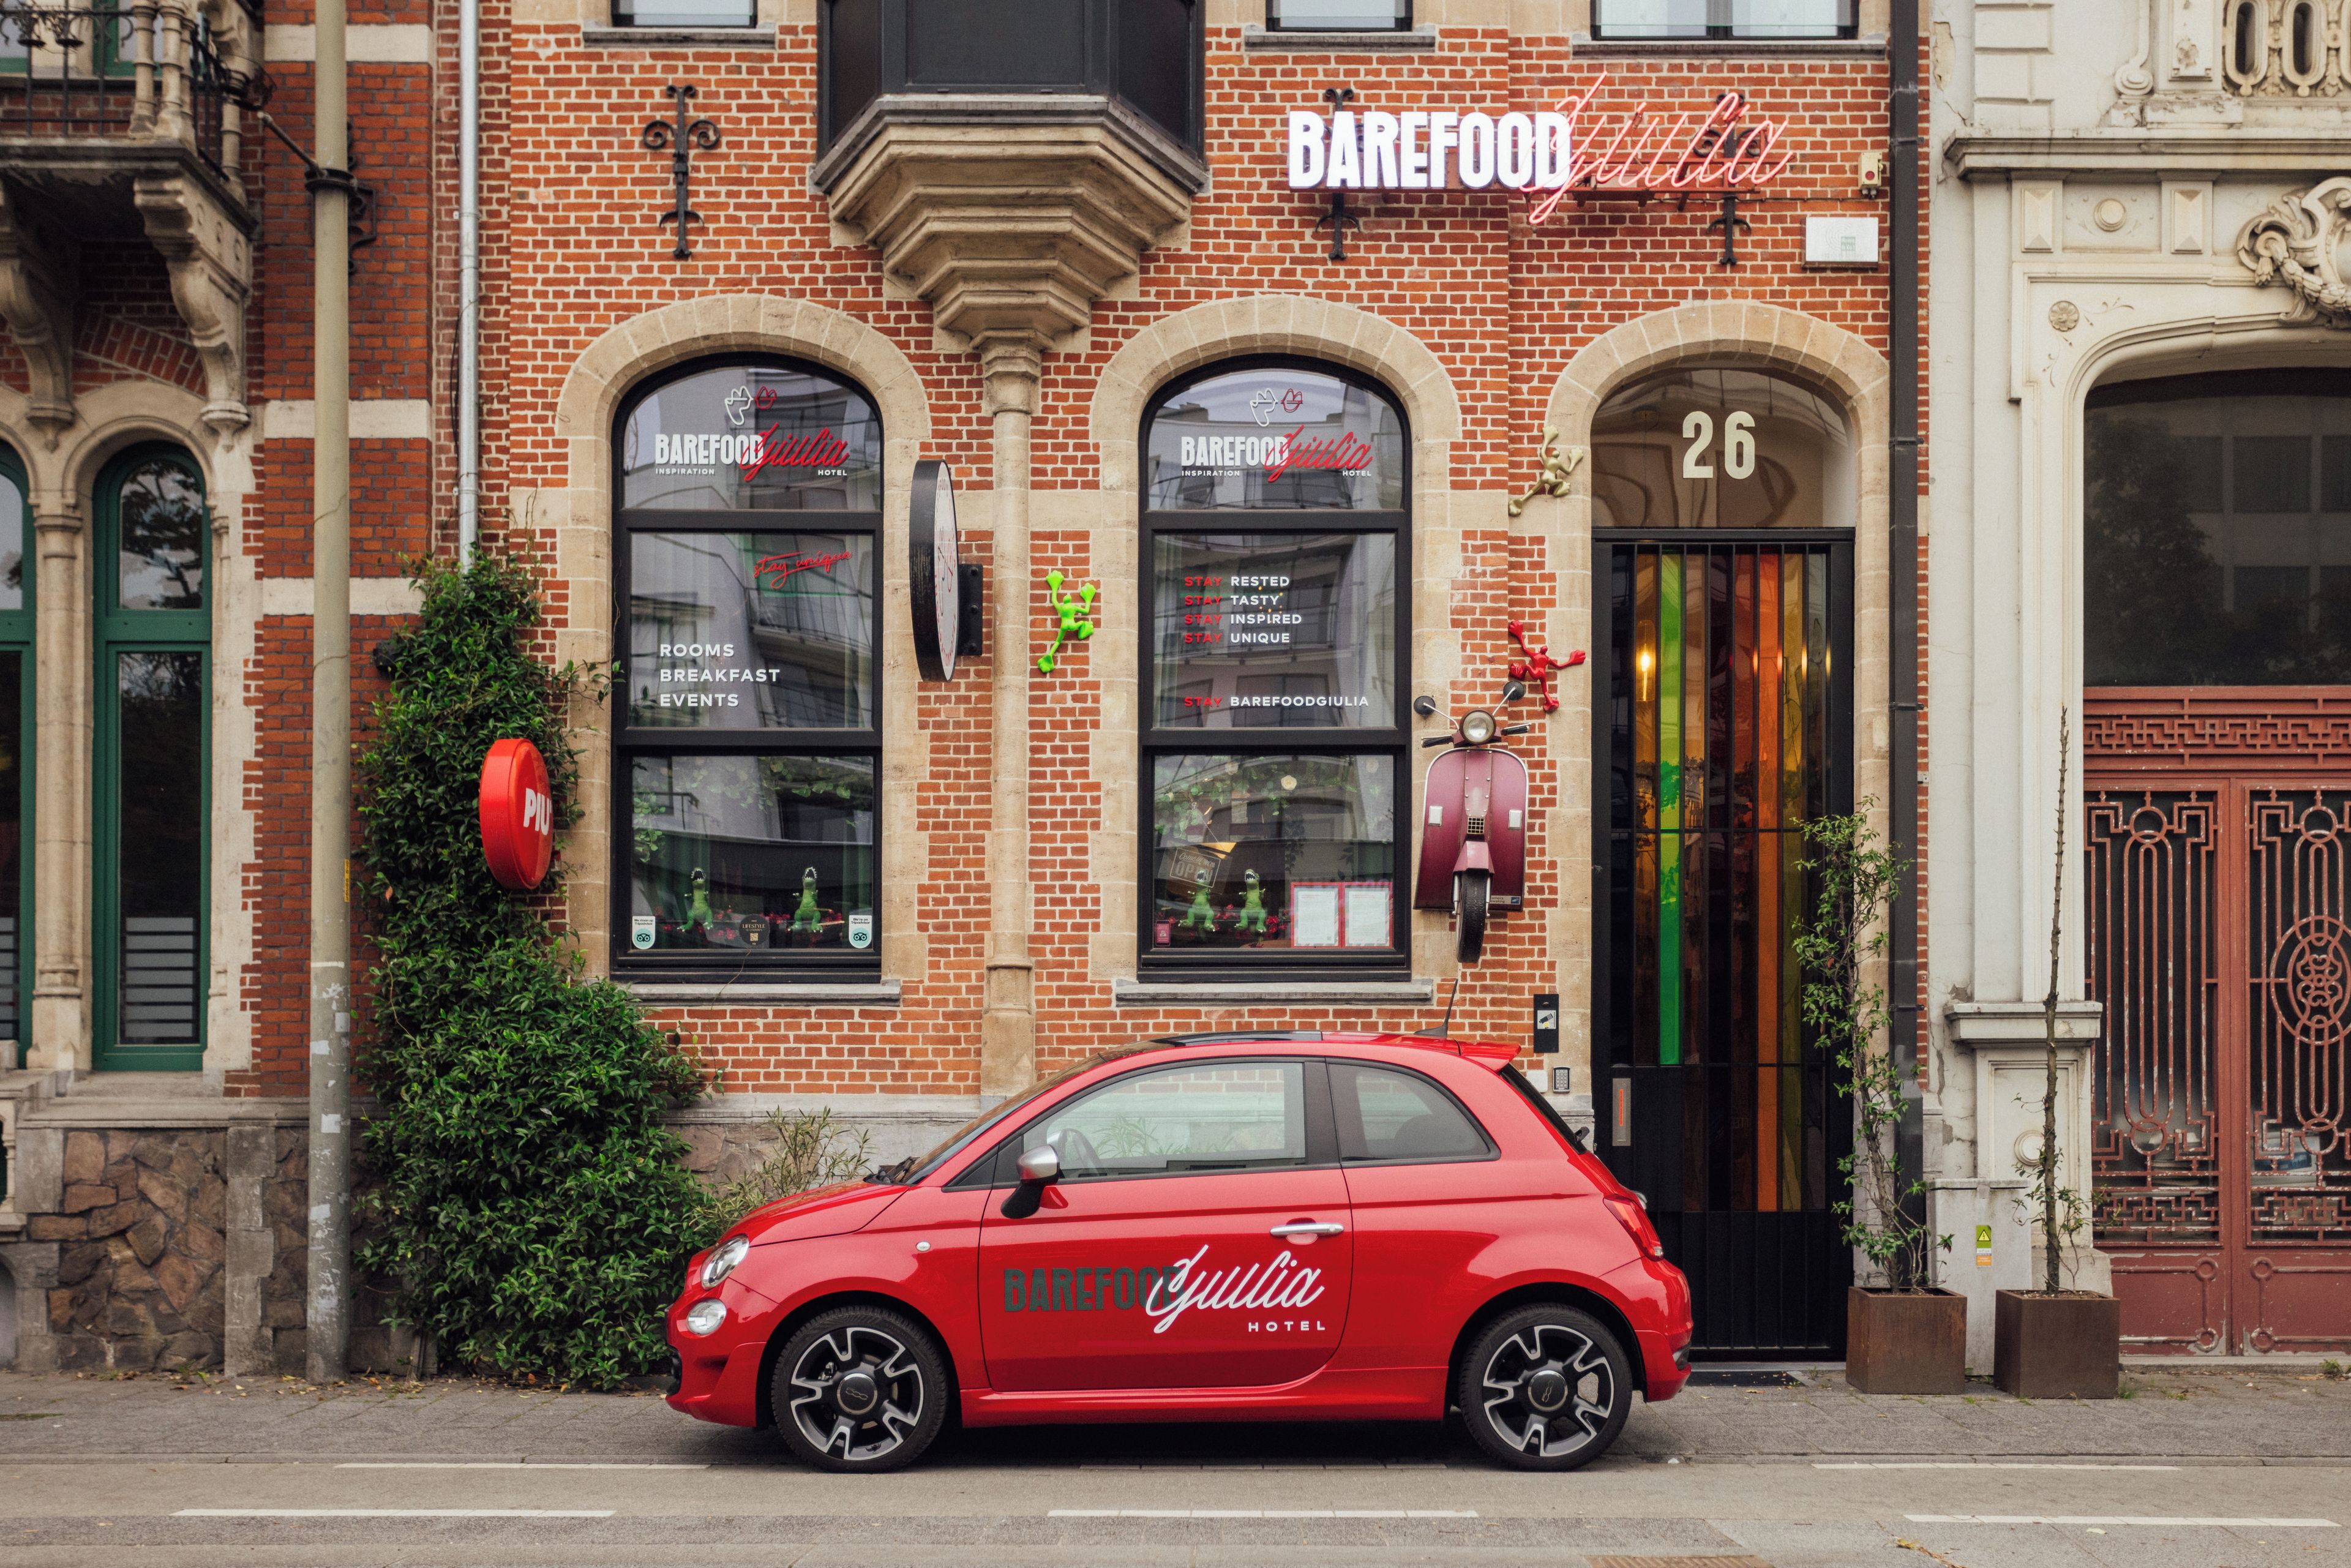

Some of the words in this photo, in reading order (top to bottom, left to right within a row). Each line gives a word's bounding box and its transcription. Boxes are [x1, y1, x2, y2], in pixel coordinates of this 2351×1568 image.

[1288, 111, 1572, 188] BAREFOOD
[1520, 70, 1794, 225] Giulia
[1682, 411, 1755, 479] 26
[655, 434, 764, 465] BAREFOOD
[740, 422, 850, 482] Giulia
[1181, 436, 1289, 467] BAREFOOD
[1264, 424, 1373, 482] Giulia
[752, 552, 794, 590] stay
[796, 550, 853, 573] unique
[1185, 577, 1222, 587] STAY
[1231, 577, 1289, 587] RESTED
[1185, 595, 1222, 605] STAY
[1231, 595, 1279, 605] TASTY
[1185, 614, 1222, 624] STAY
[1231, 614, 1302, 624] INSPIRED
[1185, 633, 1222, 643] STAY
[1231, 633, 1290, 643] UNIQUE
[660, 644, 734, 657] ROOMS
[660, 669, 780, 682] BREAKFAST
[660, 694, 739, 707] EVENTS
[1185, 696, 1222, 707] STAY
[1231, 696, 1369, 707] BAREFOODGIULIA
[1004, 1266, 1184, 1313] BAREFOOD
[1248, 1321, 1325, 1332] HOTEL
